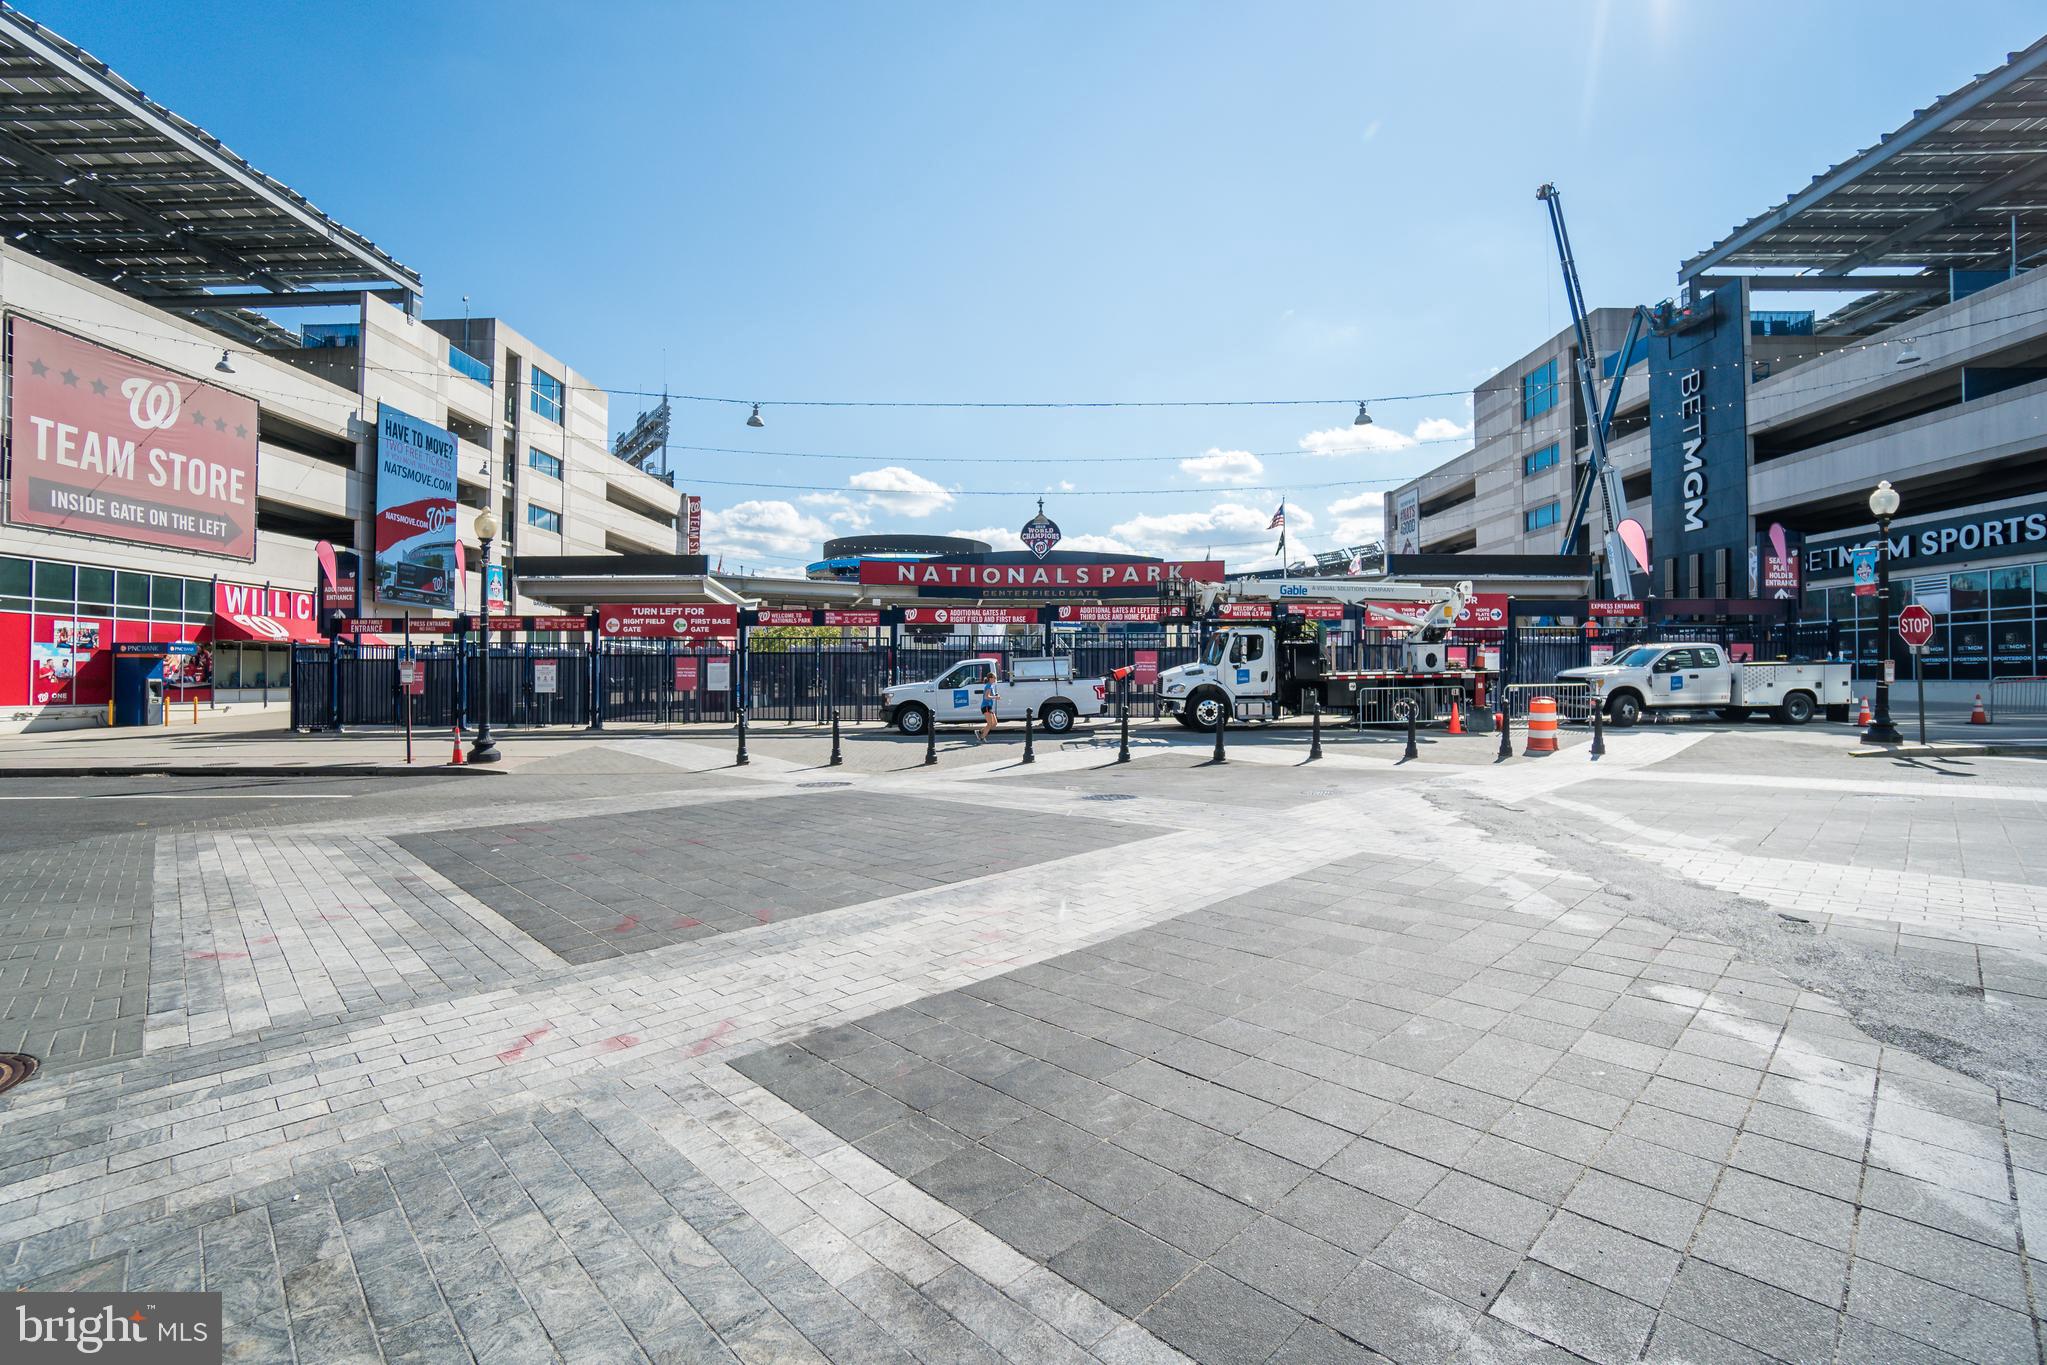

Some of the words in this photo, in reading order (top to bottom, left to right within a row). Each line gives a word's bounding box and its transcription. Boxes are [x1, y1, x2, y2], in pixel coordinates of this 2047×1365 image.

[385, 418, 409, 443] HAVE
[411, 429, 423, 448] TO
[425, 435, 454, 460] MOVE?
[1681, 370, 1704, 532] BETMGM
[30, 415, 135, 481] TEAM
[148, 448, 245, 505] STORE
[385, 438, 403, 453] TWO
[405, 445, 423, 460] FREE
[424, 452, 452, 471] TICKETS
[384, 460, 452, 493] NATSMOVE.COM
[51, 490, 105, 516] INSIDE
[110, 502, 145, 523] GATE
[150, 510, 168, 527] ON
[171, 513, 195, 531] THE
[199, 518, 227, 537] LEFT
[385, 511, 428, 529] NATSMOVE.COM
[690, 515, 700, 539] TEAM
[1021, 532, 1060, 540] CHAMPIONS
[1921, 513, 2047, 556] SPORTS
[898, 565, 1090, 584] NATIONALS
[1102, 565, 1184, 583] PARK
[224, 585, 286, 618] WILL
[297, 594, 318, 621] C
[982, 590, 1033, 598] CENTER
[1280, 585, 1308, 596] Gable
[1080, 606, 1111, 614] ADDITIONAL
[1901, 618, 1930, 634] STOP
